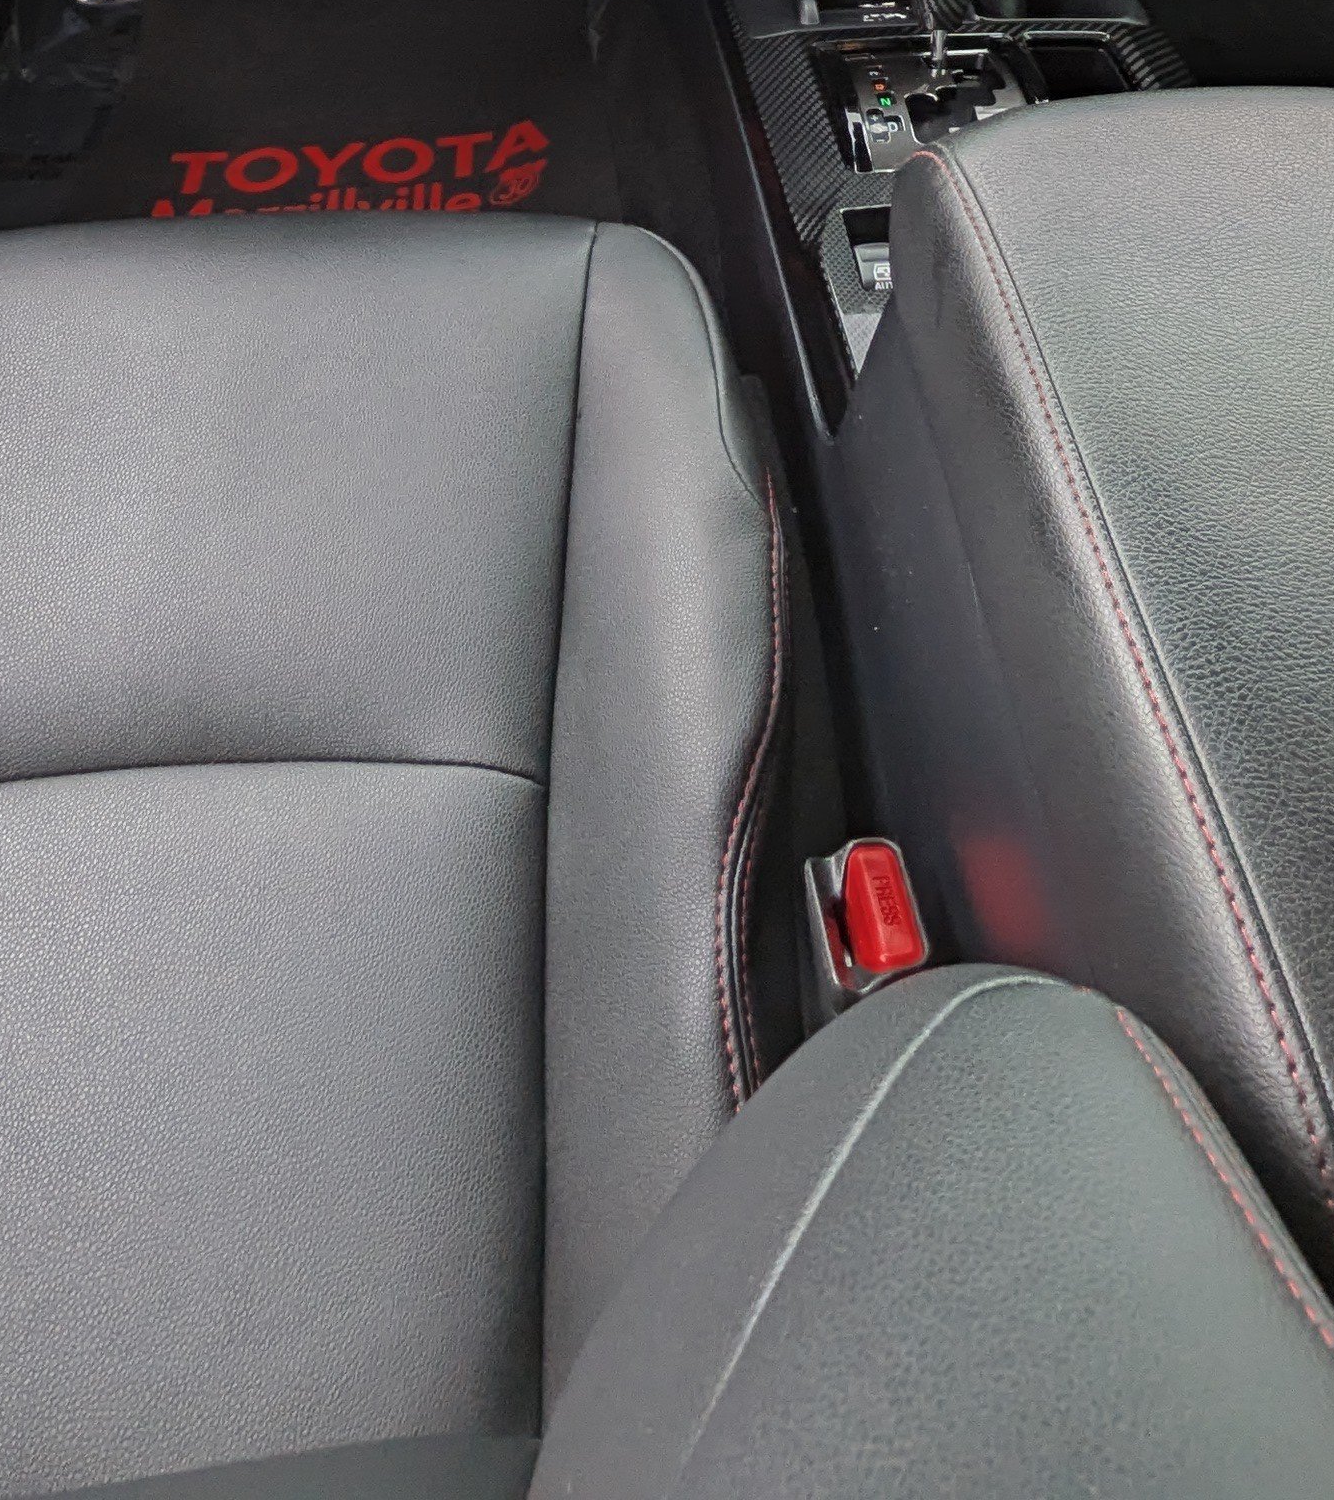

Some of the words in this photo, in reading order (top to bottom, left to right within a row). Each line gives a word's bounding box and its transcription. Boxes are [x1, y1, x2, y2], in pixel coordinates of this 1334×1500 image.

[880, 97, 891, 106] N
[171, 119, 550, 195] TOYOTA
[872, 876, 902, 925] PRESS
